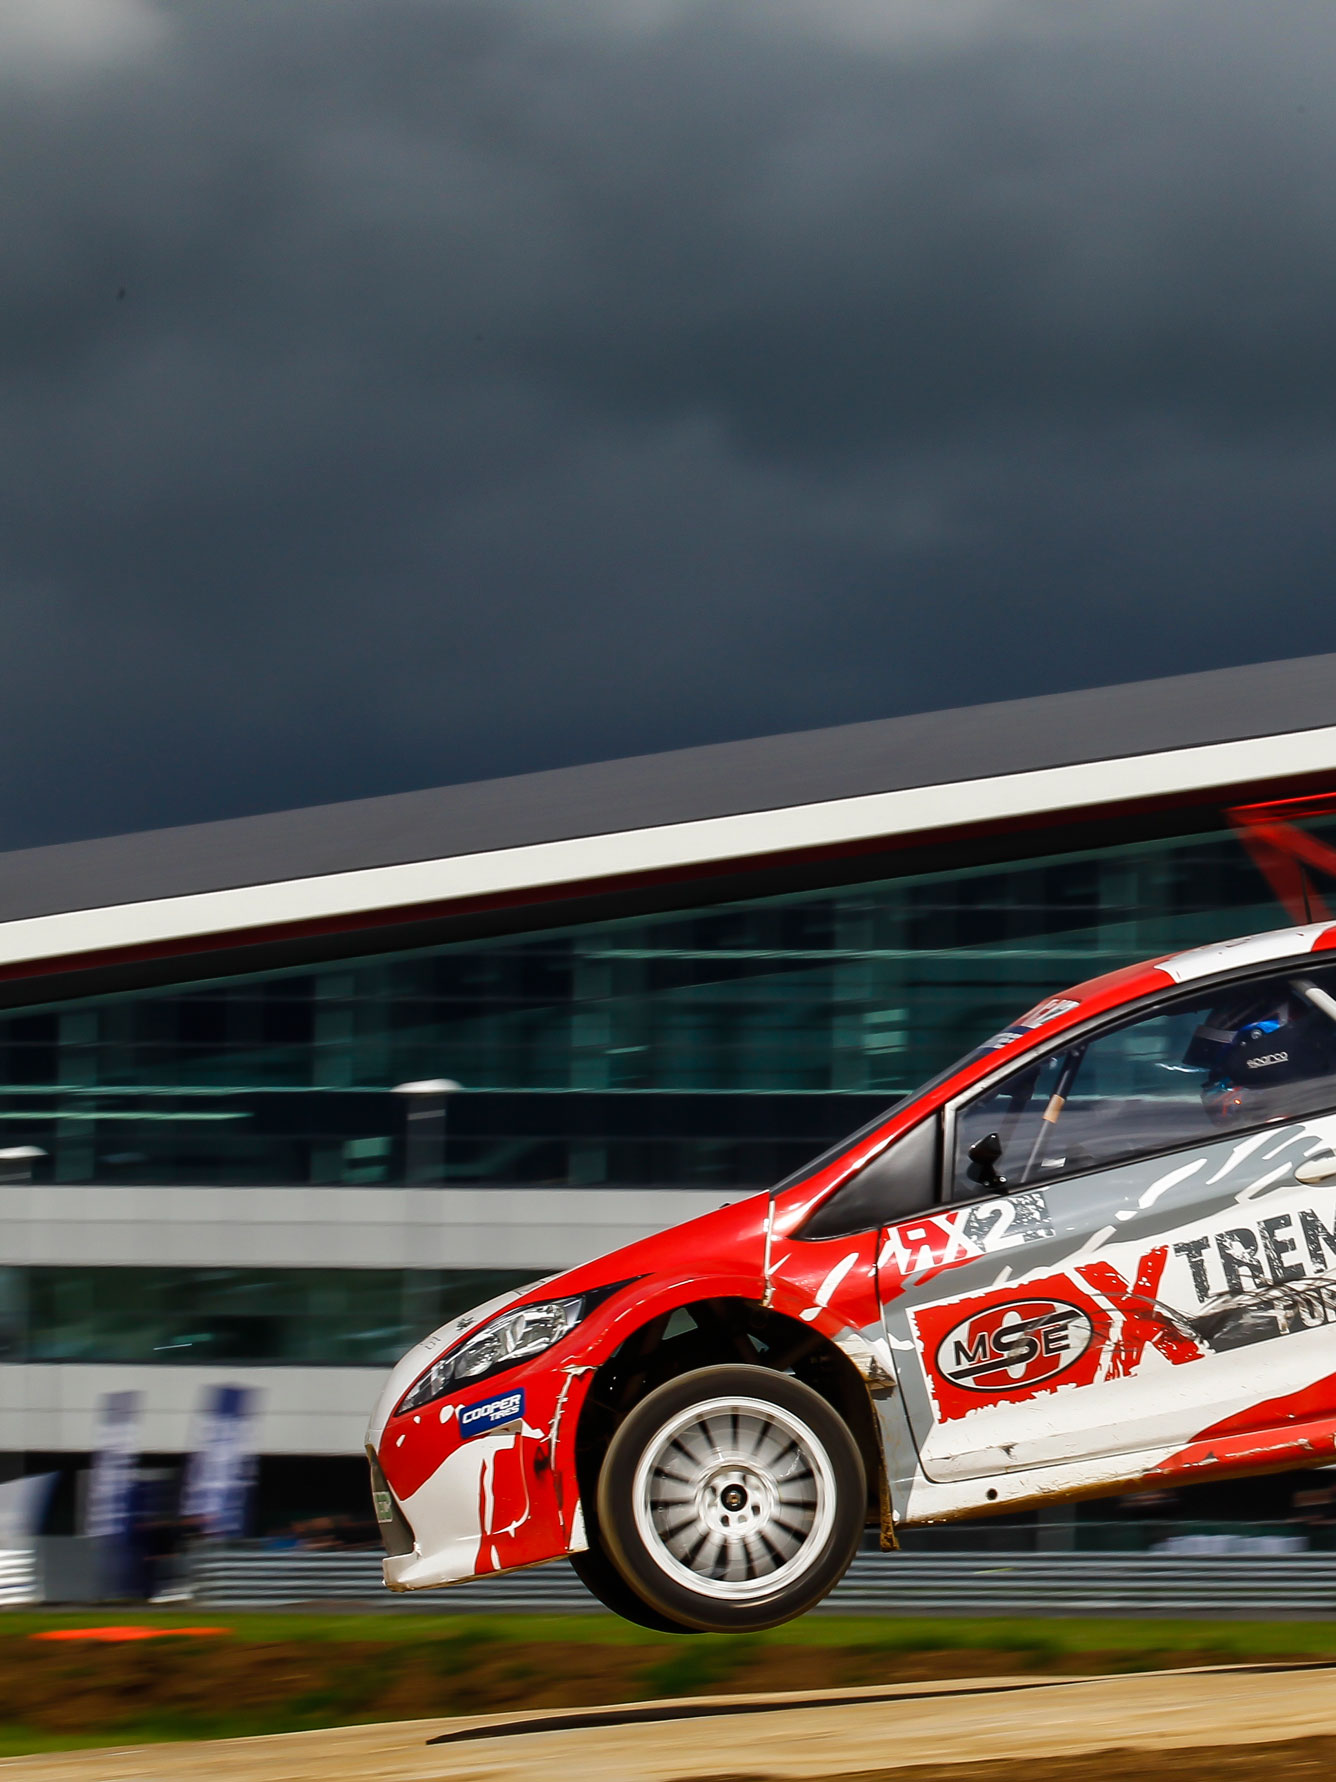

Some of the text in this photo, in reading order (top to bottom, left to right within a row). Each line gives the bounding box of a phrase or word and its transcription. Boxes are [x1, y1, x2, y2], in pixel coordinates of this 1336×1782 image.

[1246, 1051, 1289, 1069] sparco
[949, 1311, 1078, 1377] MSE
[462, 1393, 522, 1425] COOPER
[489, 1404, 520, 1421] TIRES
